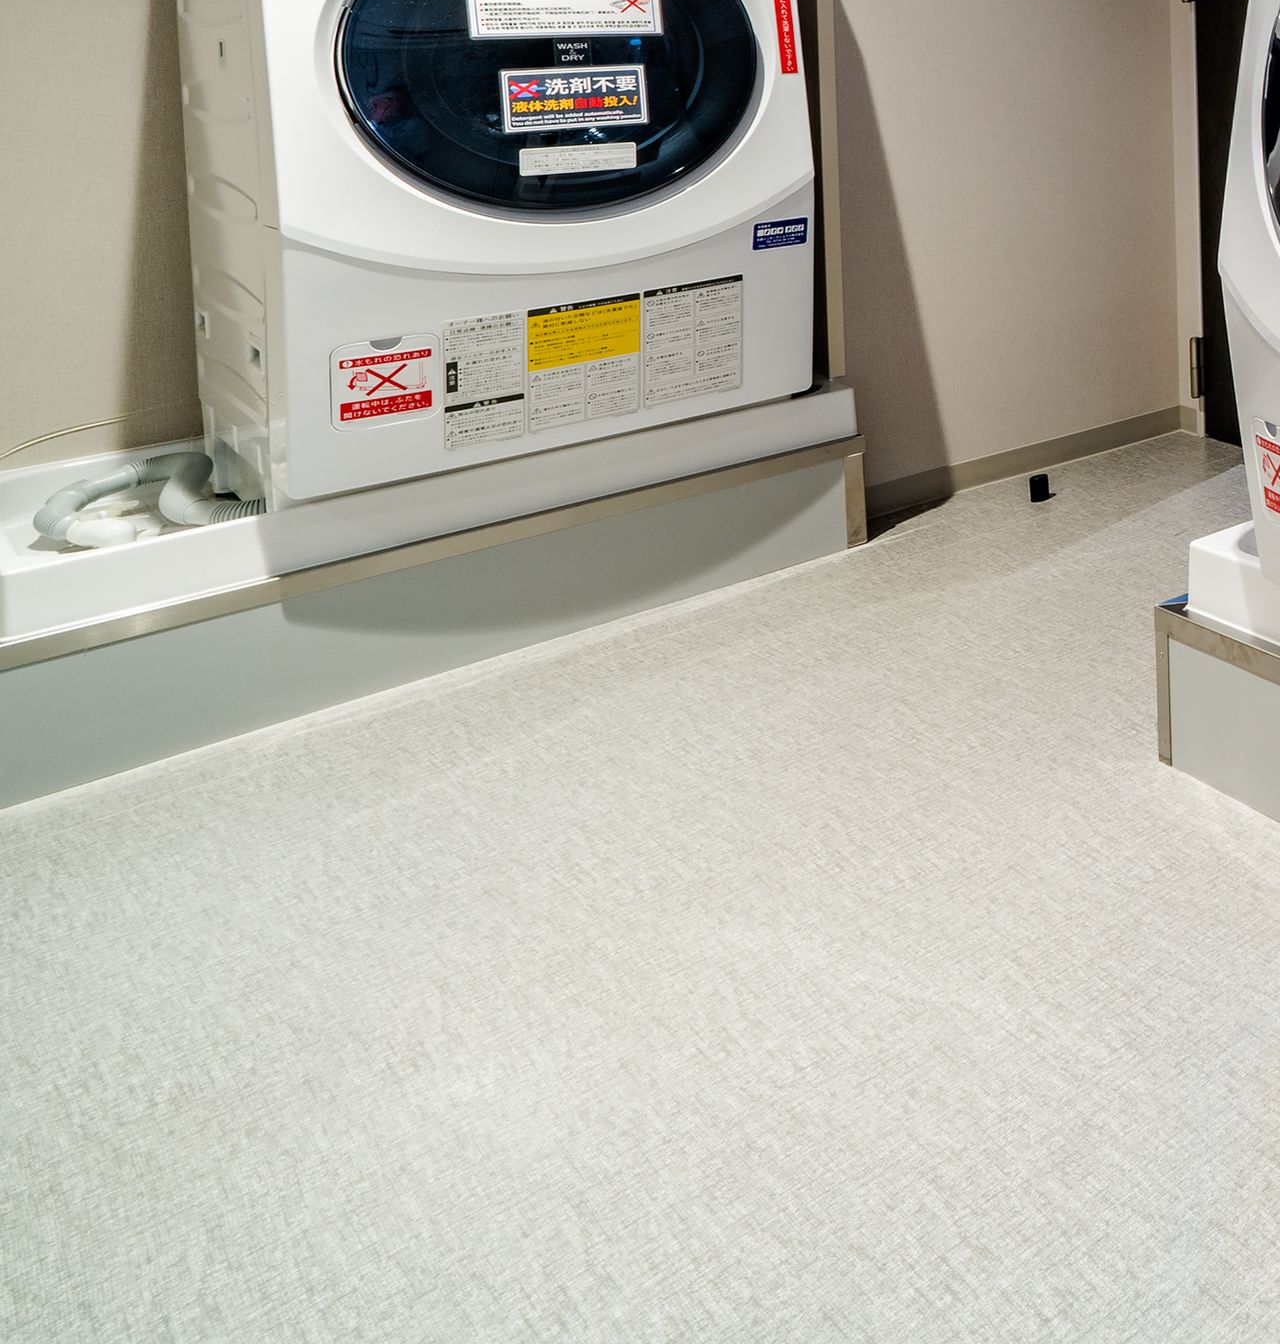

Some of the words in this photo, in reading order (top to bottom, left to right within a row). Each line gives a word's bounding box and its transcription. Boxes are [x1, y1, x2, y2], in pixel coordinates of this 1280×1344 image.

[557, 42, 588, 50] WASH
[561, 54, 585, 62] DRY
[545, 75, 637, 96] 洗剤不要
[512, 96, 638, 113] 液体洗剤自動投入!
[354, 349, 430, 367] 水もれの恐れあり
[343, 400, 431, 420] 開けないでください。
[351, 393, 423, 410] 運転中は、ふたを
